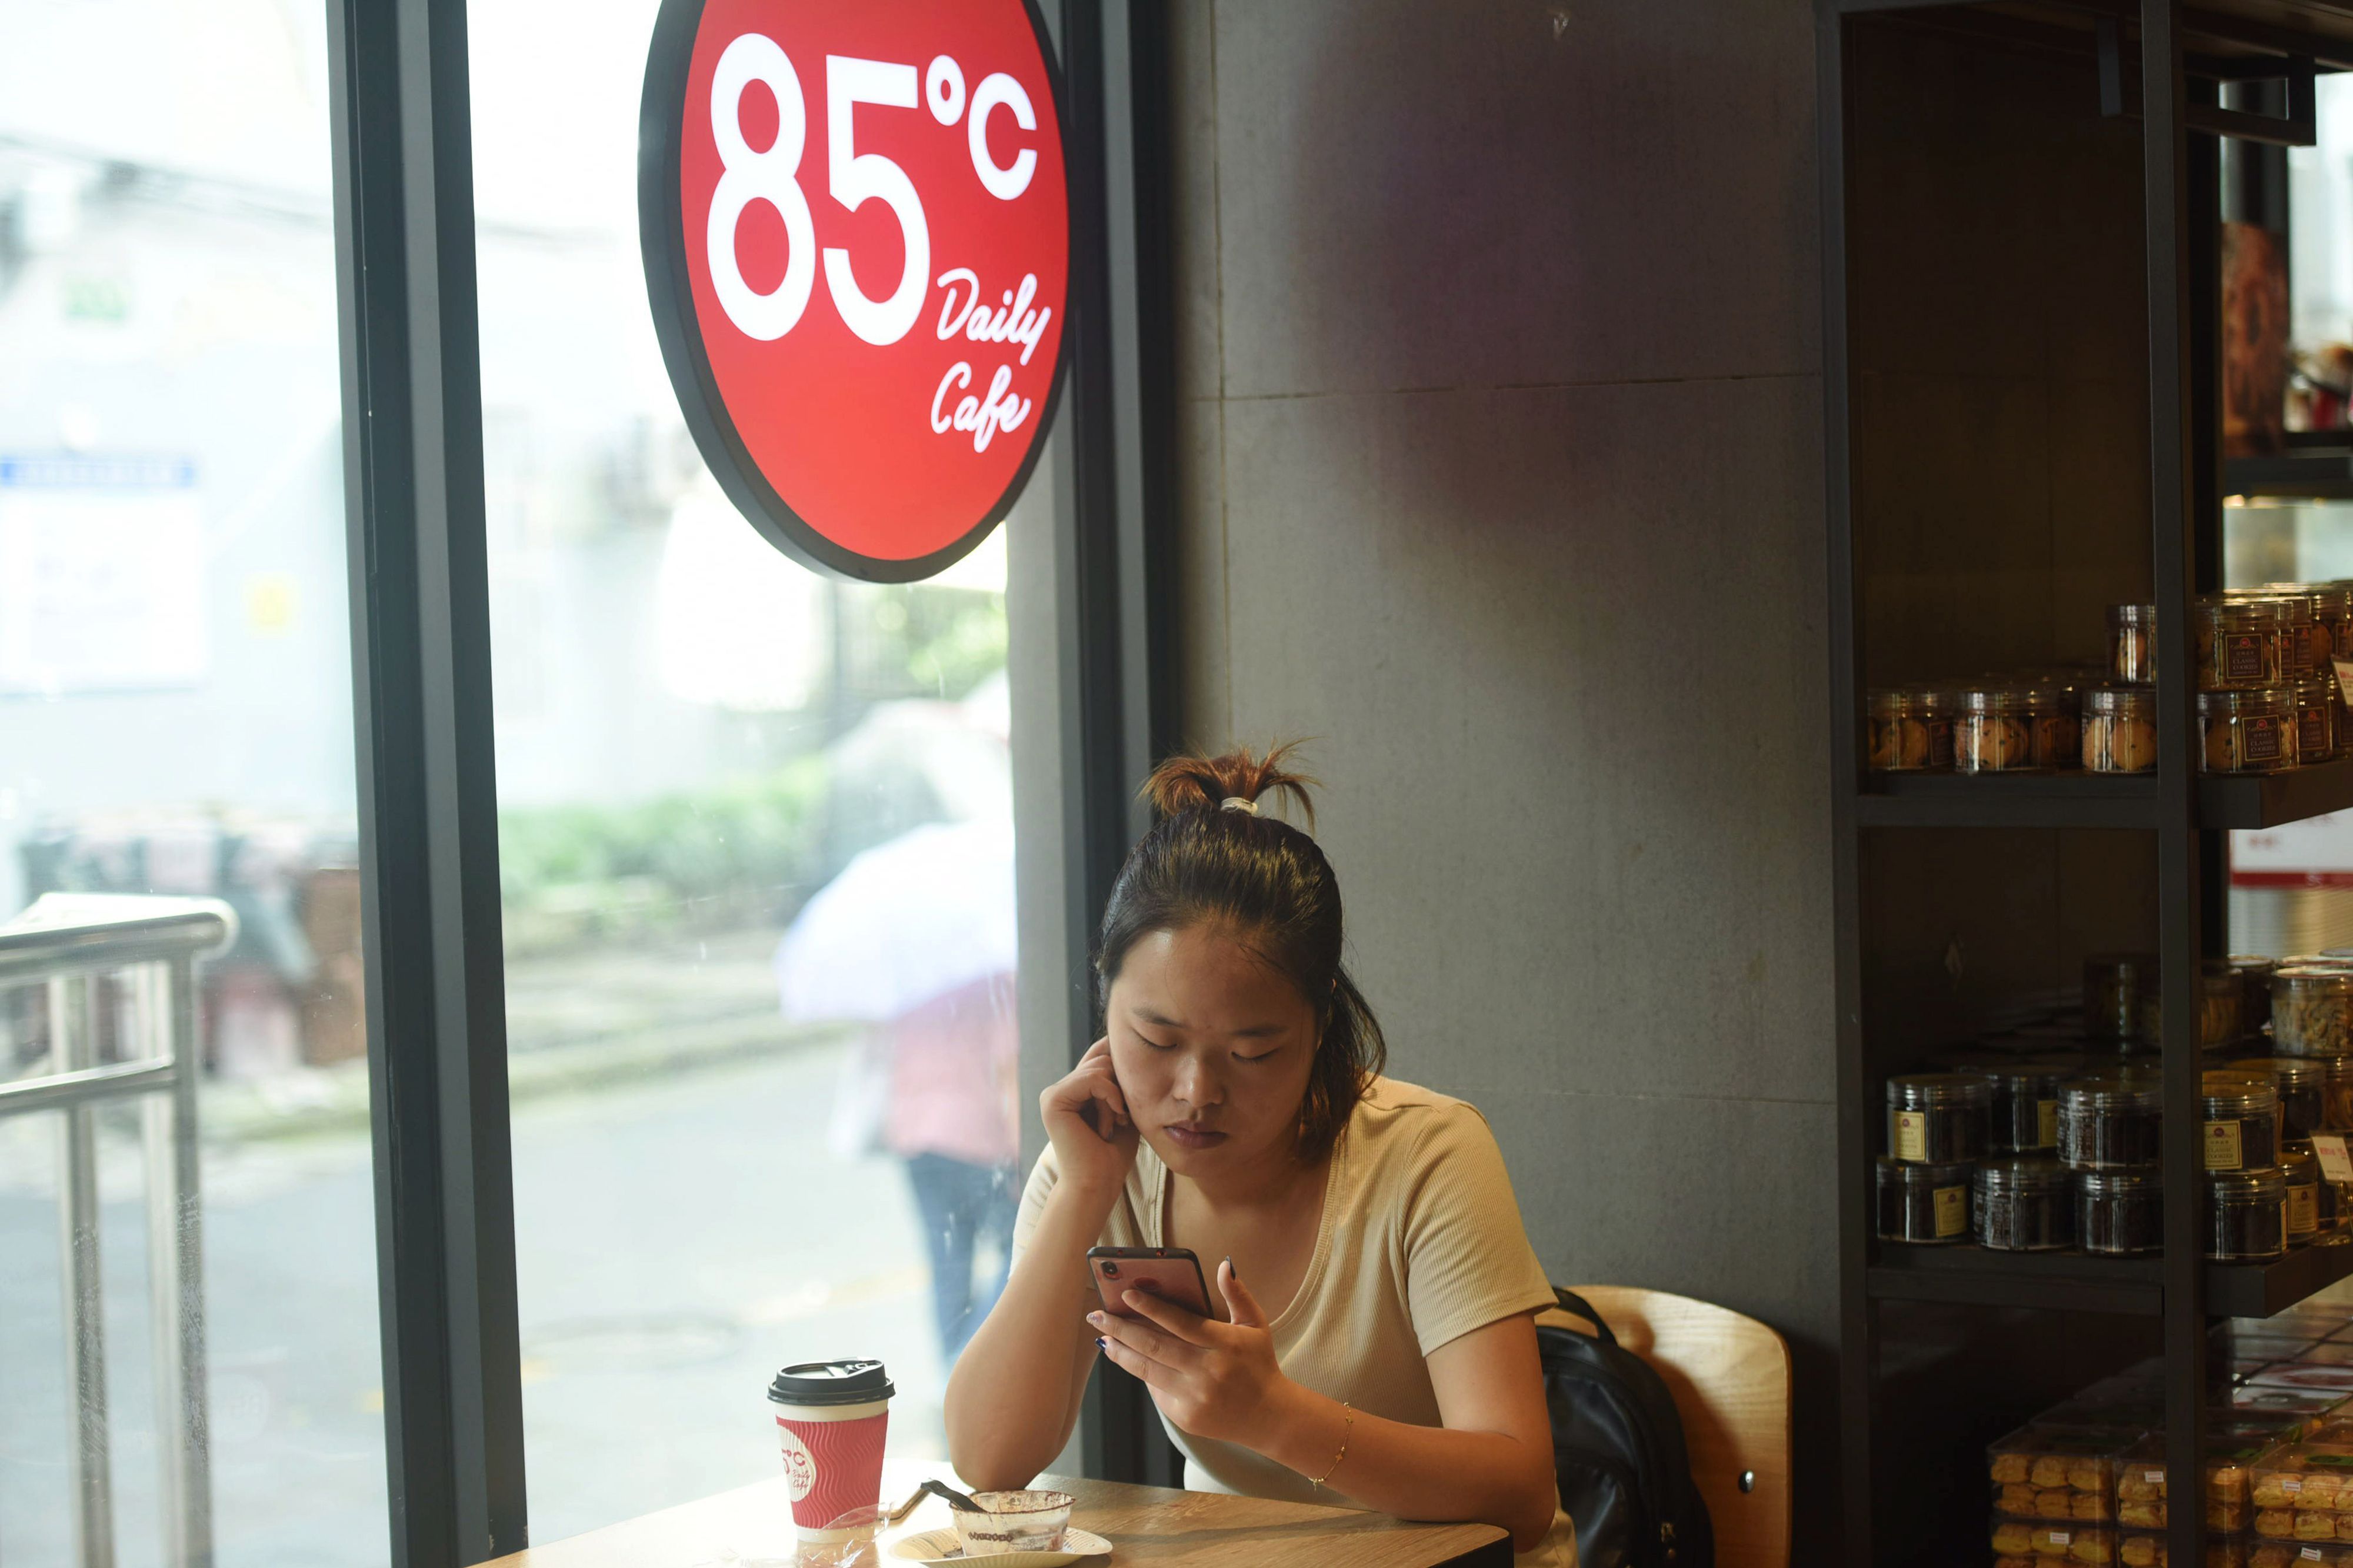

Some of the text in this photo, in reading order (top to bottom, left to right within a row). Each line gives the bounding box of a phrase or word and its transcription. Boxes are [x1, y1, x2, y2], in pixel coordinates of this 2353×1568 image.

[707, 32, 1038, 346] 85°C
[937, 267, 1051, 366] Daily
[931, 361, 1031, 453] Cafe
